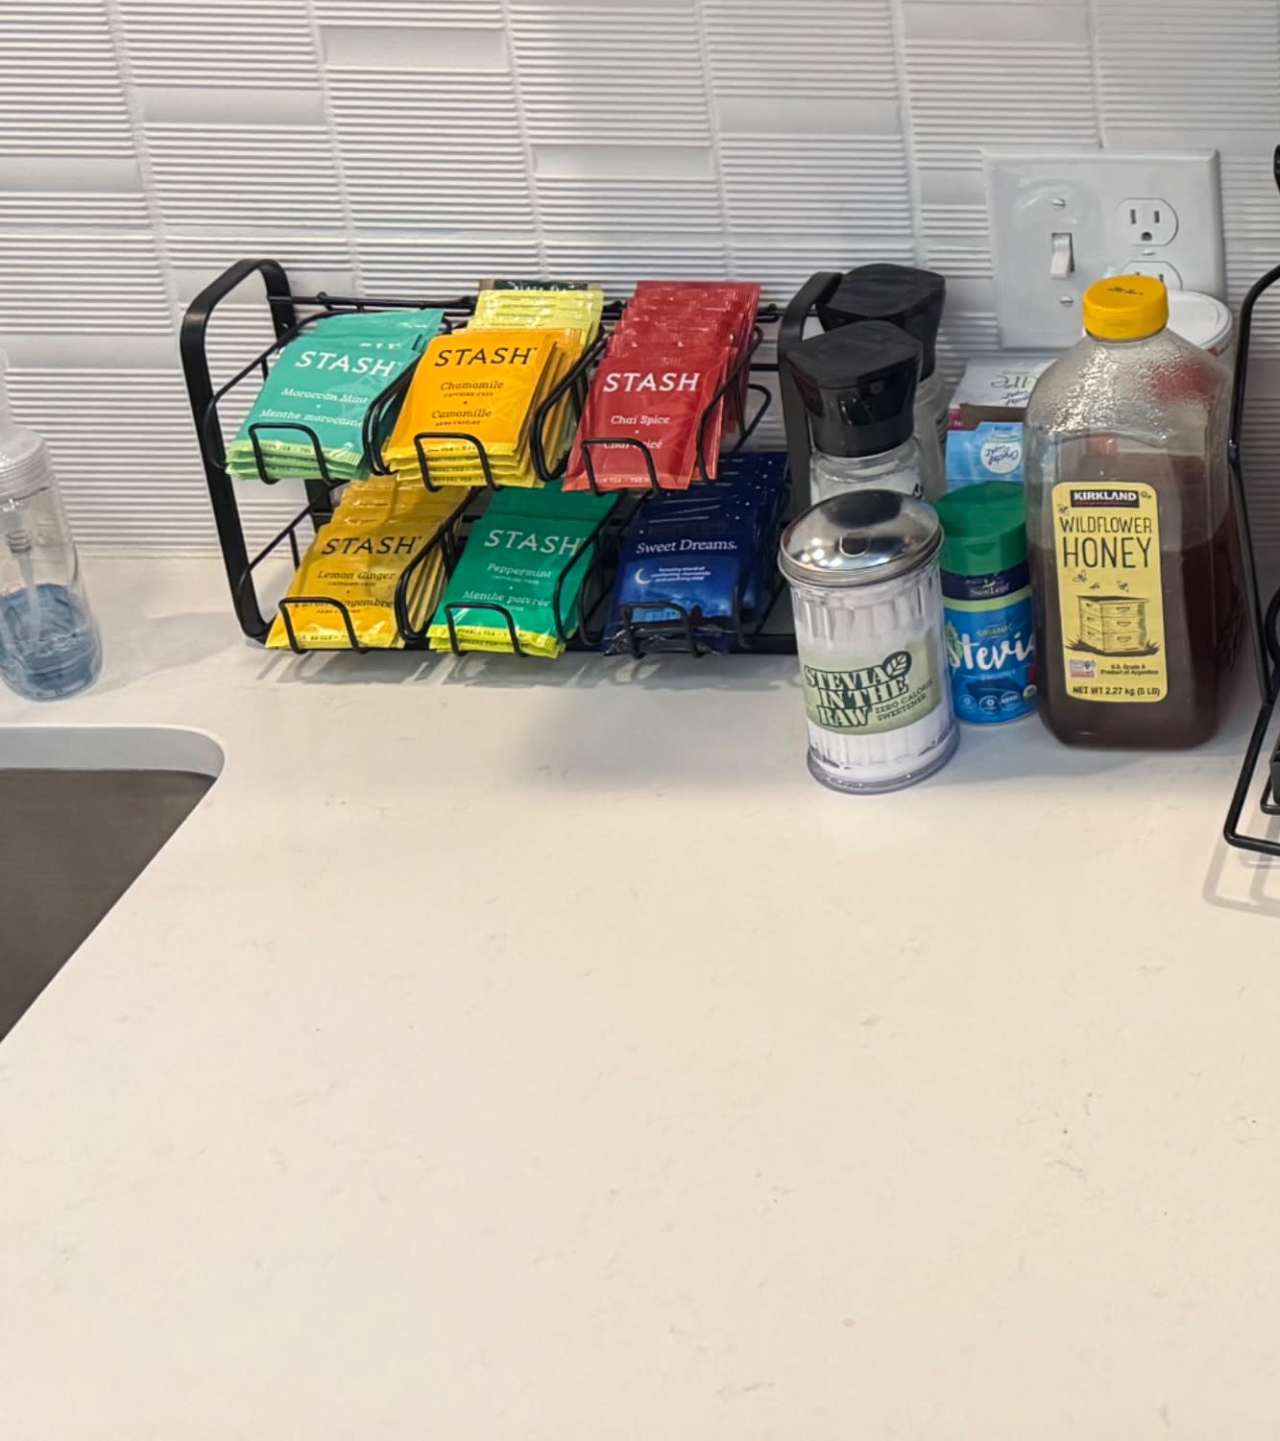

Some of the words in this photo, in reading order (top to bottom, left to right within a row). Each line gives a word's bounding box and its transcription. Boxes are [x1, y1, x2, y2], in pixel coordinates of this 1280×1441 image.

[296, 351, 396, 377] STASH
[434, 346, 533, 367] STASH
[440, 380, 504, 391] Chamomile
[603, 373, 700, 392] STASH
[431, 409, 492, 420] Camomille
[611, 415, 637, 425] Chai
[640, 416, 670, 426] Spice
[1073, 491, 1137, 501] KIRKLAND
[1059, 516, 1152, 533] WILDFLOWER
[321, 535, 421, 556] STASH
[484, 529, 581, 557] STASH
[636, 542, 676, 555] Sweet
[1063, 536, 1151, 568] HONEY
[318, 570, 354, 580] Lemon
[487, 563, 552, 579] Peppermint
[804, 664, 888, 691] STEVIA
[853, 675, 909, 707] THE
[1073, 686, 1088, 694] NET
[1091, 687, 1103, 695] WT
[1105, 687, 1122, 695] 2.27
[1125, 687, 1135, 696] kg
[817, 704, 872, 728] RAW
